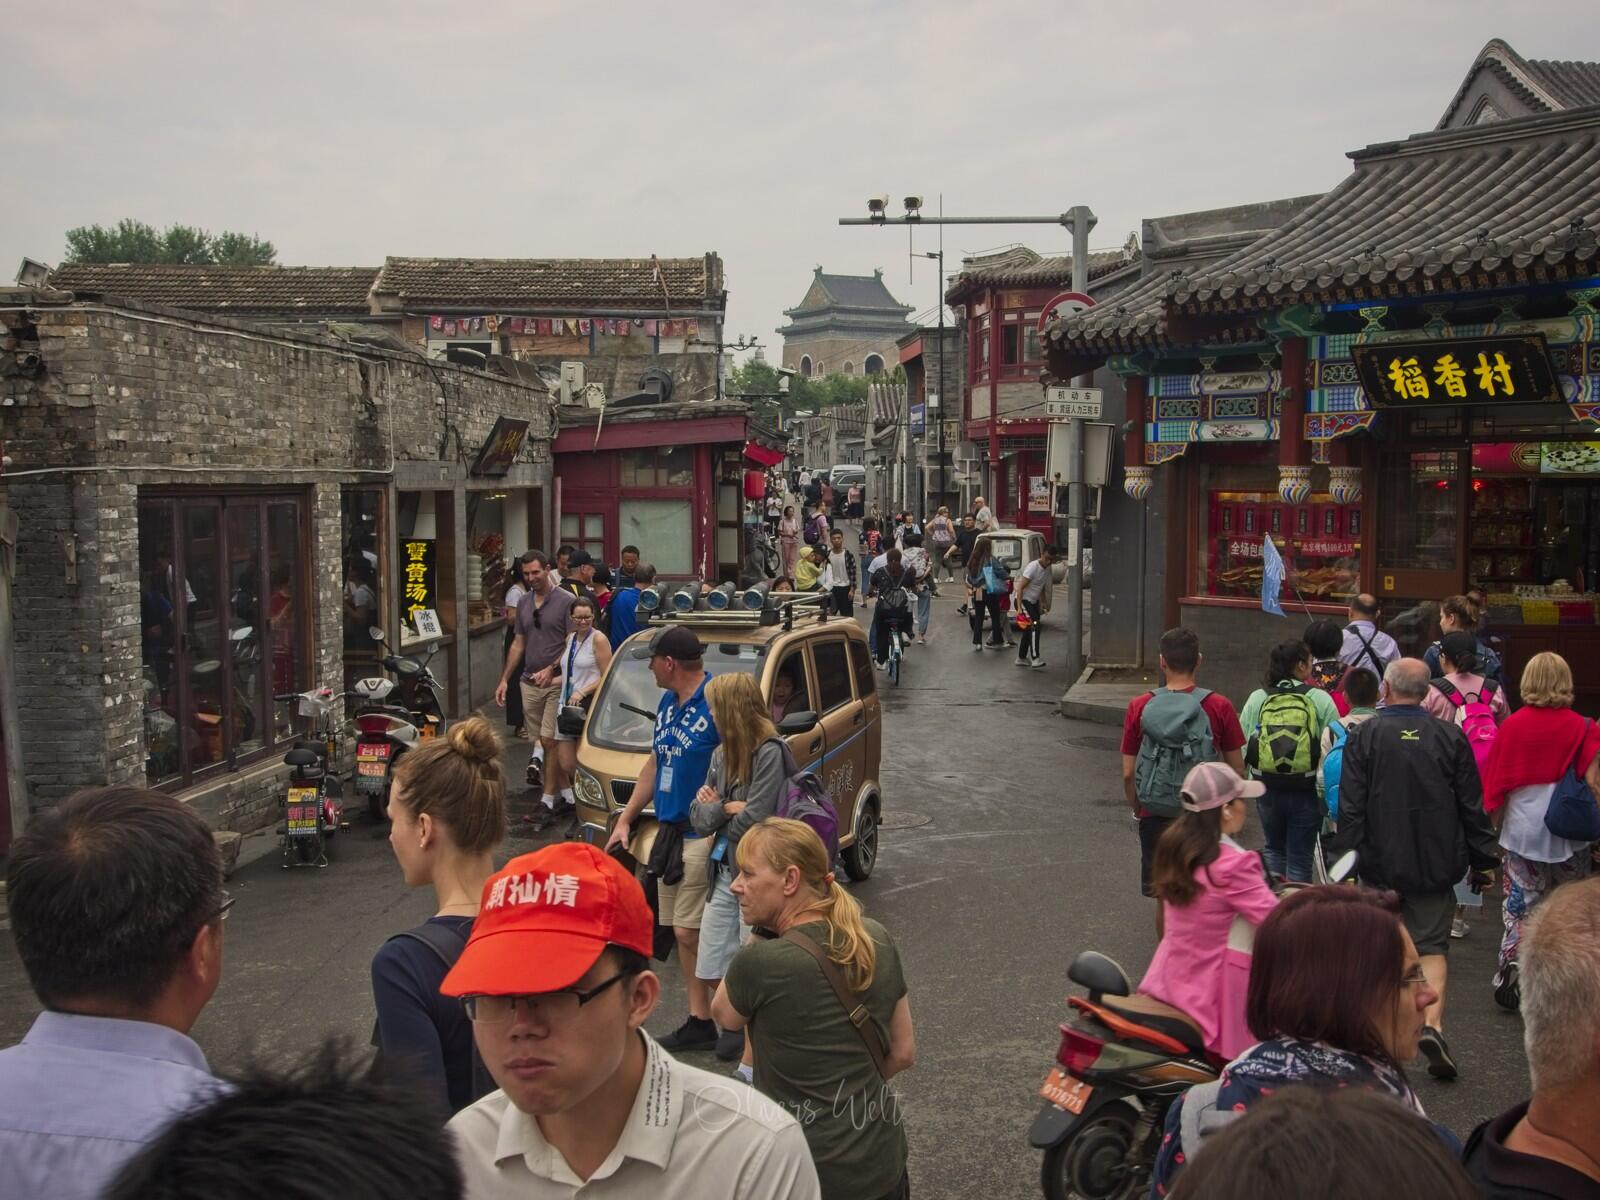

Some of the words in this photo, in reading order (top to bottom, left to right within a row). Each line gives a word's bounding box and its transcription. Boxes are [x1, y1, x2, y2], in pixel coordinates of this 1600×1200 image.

[1387, 353, 1515, 399] 稻香村
[1058, 391, 1092, 400] 机动车
[655, 705, 709, 733] JEEP
[655, 726, 693, 750] PERFMANCE
[485, 872, 581, 910] 潮汕情
